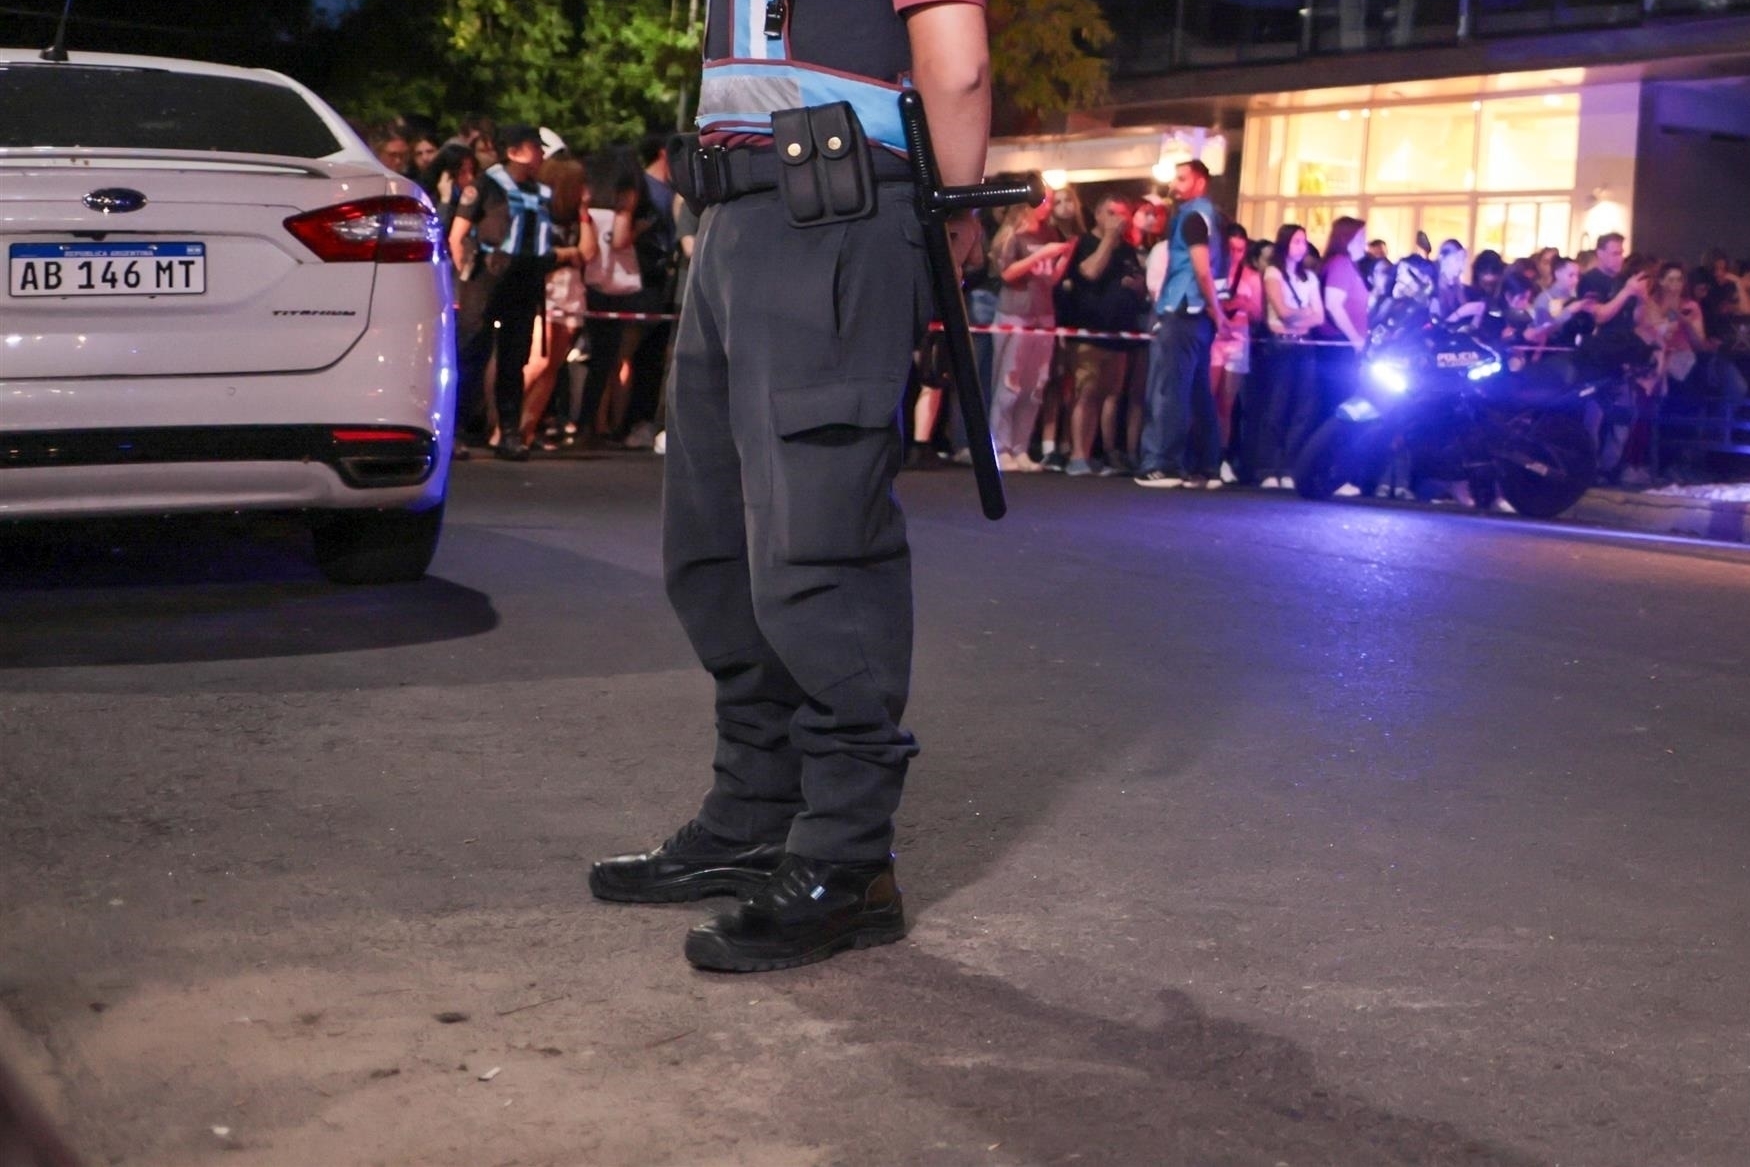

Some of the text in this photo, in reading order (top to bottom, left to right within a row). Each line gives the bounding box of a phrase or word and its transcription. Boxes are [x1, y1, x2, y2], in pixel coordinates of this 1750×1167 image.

[20, 260, 195, 290] AB 146 MT
